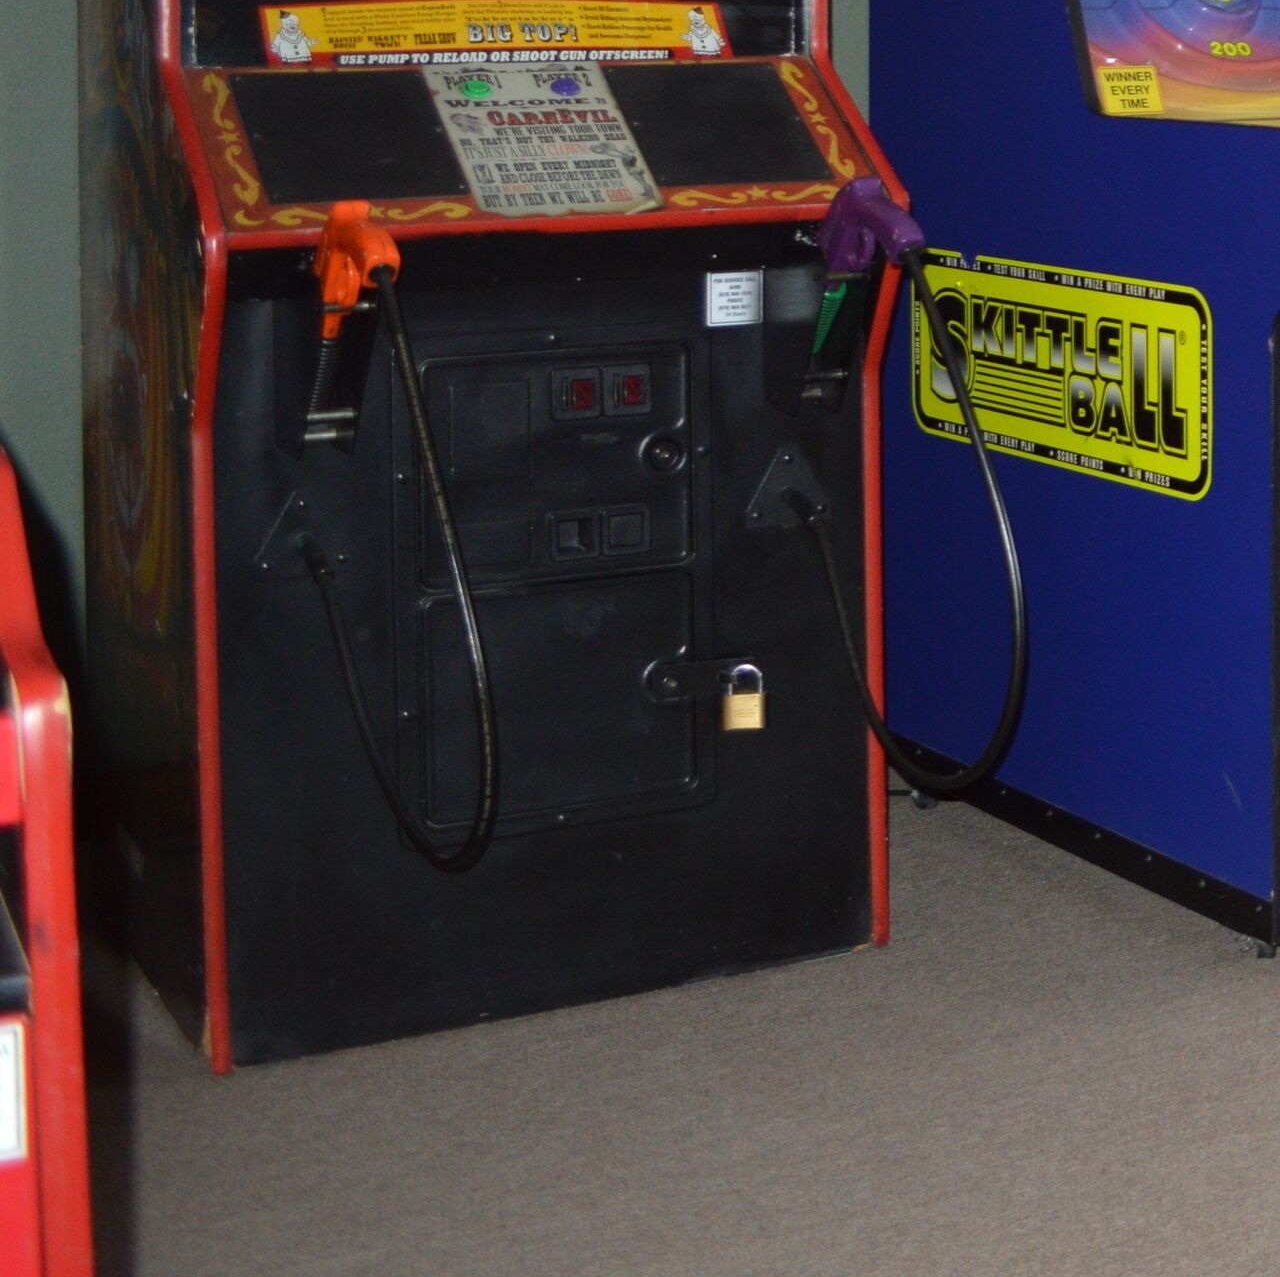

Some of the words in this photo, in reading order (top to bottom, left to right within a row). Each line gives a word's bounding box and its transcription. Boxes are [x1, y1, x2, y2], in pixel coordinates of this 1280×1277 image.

[467, 22, 514, 43] BIG
[518, 22, 579, 43] TOP!
[339, 55, 366, 66] USE
[368, 53, 411, 66] PUMP
[411, 52, 431, 64] TO
[432, 51, 488, 64] RELOAD
[493, 51, 510, 63] OR
[512, 50, 557, 63] SHOOT
[561, 50, 591, 62] GUN
[592, 49, 670, 61] OFFSCREEN!
[1210, 40, 1252, 58] 200
[1103, 70, 1154, 84] WINNER
[1110, 84, 1152, 97] EVERY
[444, 98, 590, 108] WELCOME
[1118, 97, 1150, 110] TIME
[493, 125, 526, 136] WE'RE
[527, 124, 567, 135] VISITING
[569, 124, 595, 134] YOUR
[597, 123, 623, 133] TOWN
[559, 134, 600, 143] WALKING
[494, 162, 511, 172] WE
[540, 160, 569, 171] EVERY
[573, 159, 617, 170] MIDNIGHT
[545, 170, 582, 182] BEFORE
[582, 169, 601, 181] THE
[481, 195, 504, 208] BUT
[503, 194, 520, 206] BY
[520, 193, 548, 206] THEN
[550, 192, 565, 205] WE
[564, 191, 588, 204] WILL
[590, 190, 606, 202] BE
[994, 264, 1009, 275] TEST
[1010, 266, 1026, 278] YOUR
[1028, 269, 1046, 282] SKILL
[1061, 274, 1074, 286] WIN
[1084, 278, 1104, 291] PRIZE
[1106, 281, 1123, 294] WITH
[1125, 284, 1147, 298] EVERY
[1149, 288, 1166, 301] PLAY
[1200, 339, 1208, 372] TEST
[1068, 323, 1189, 459] BALL
[1200, 379, 1208, 413] YOUR
[1200, 422, 1208, 461] SKILL
[983, 431, 998, 444] WITH
[1000, 435, 1019, 449] EVERY
[1020, 440, 1036, 453] PLAY
[1056, 449, 1078, 464] SCORE
[1080, 455, 1104, 471] POINTS
[1145, 471, 1171, 487] PRIZES
